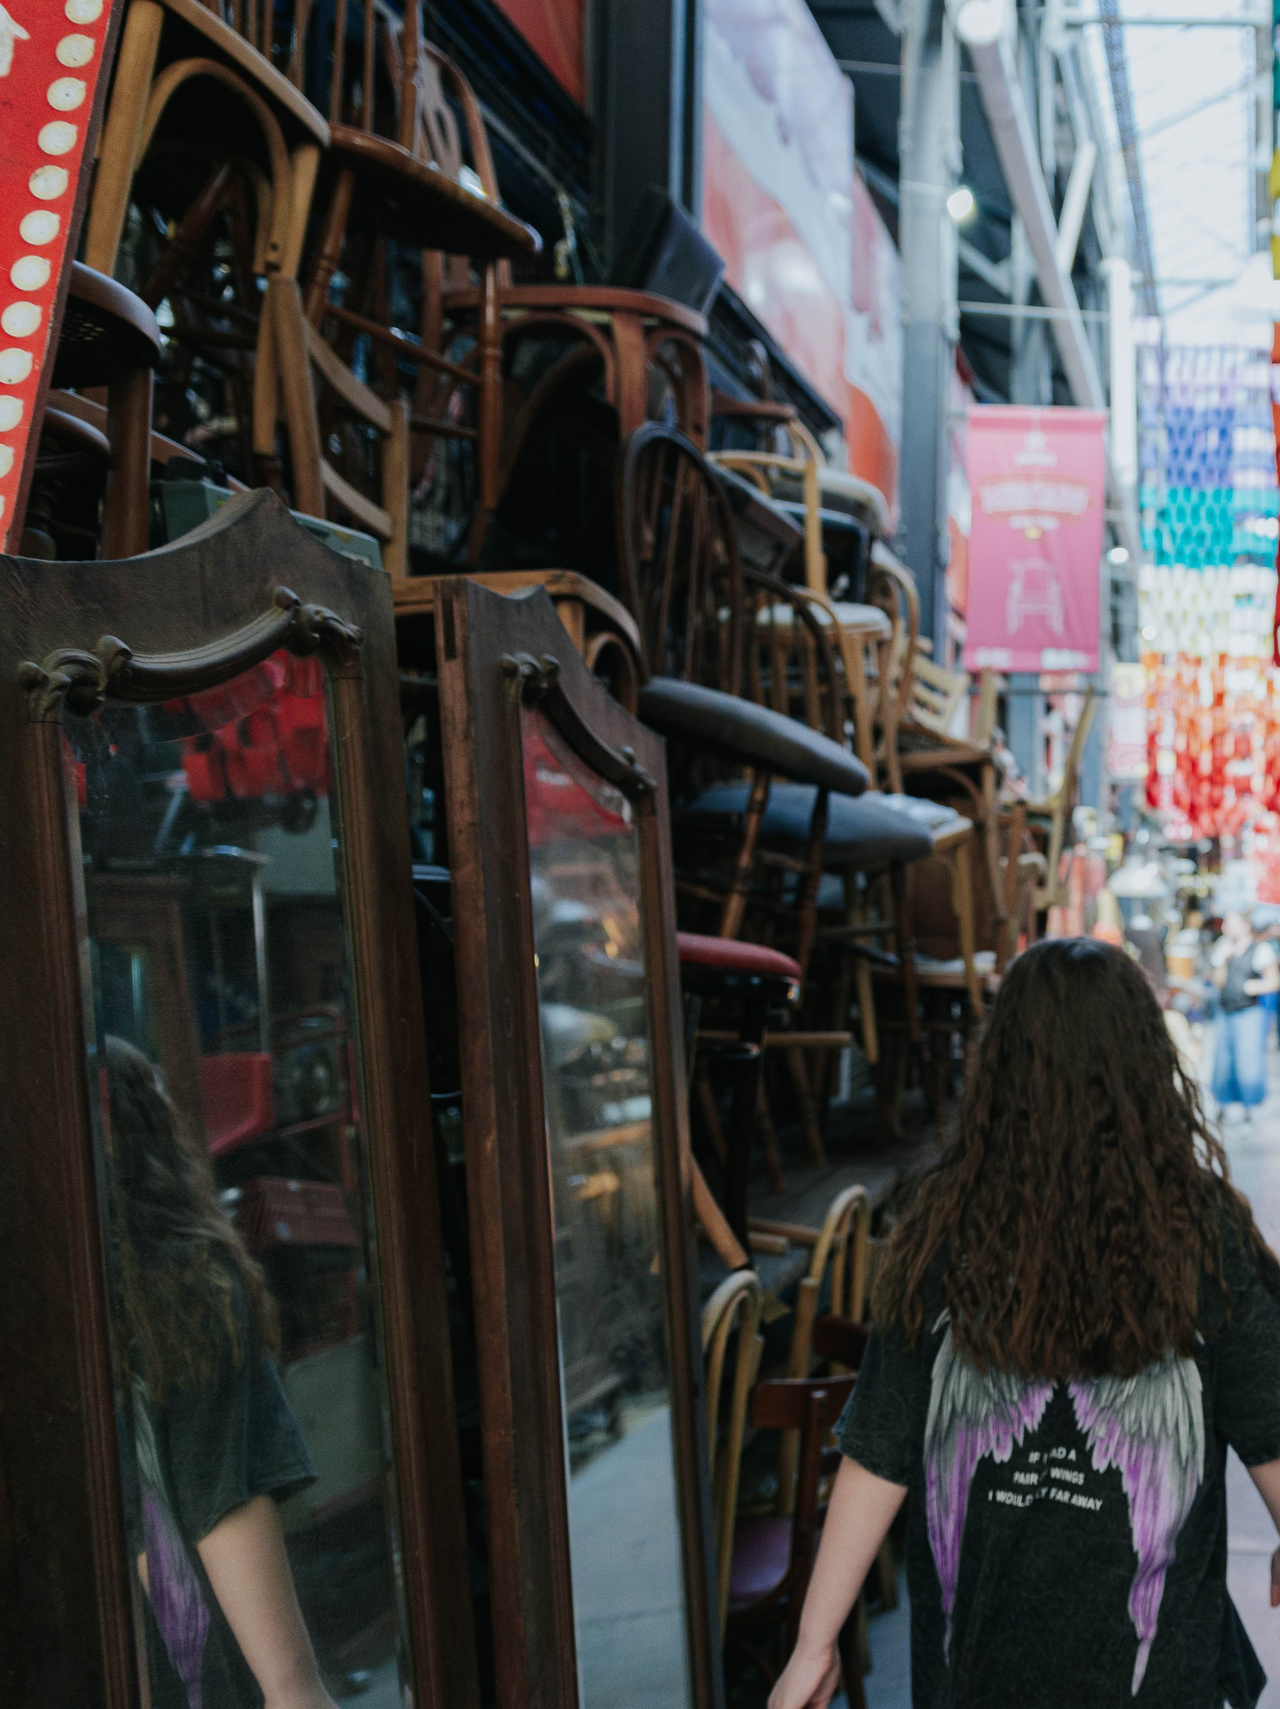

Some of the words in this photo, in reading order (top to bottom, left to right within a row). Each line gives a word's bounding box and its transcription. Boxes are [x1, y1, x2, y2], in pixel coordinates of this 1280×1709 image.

[1028, 1451, 1041, 1464] IF
[1067, 1448, 1077, 1462] A
[1013, 1470, 1039, 1485] PAIR
[1049, 1466, 1085, 1486] WINGS
[988, 1489, 993, 1502] I
[995, 1489, 1034, 1508] WOULD
[1049, 1487, 1071, 1504] FAR
[1070, 1494, 1103, 1512] AWAY
